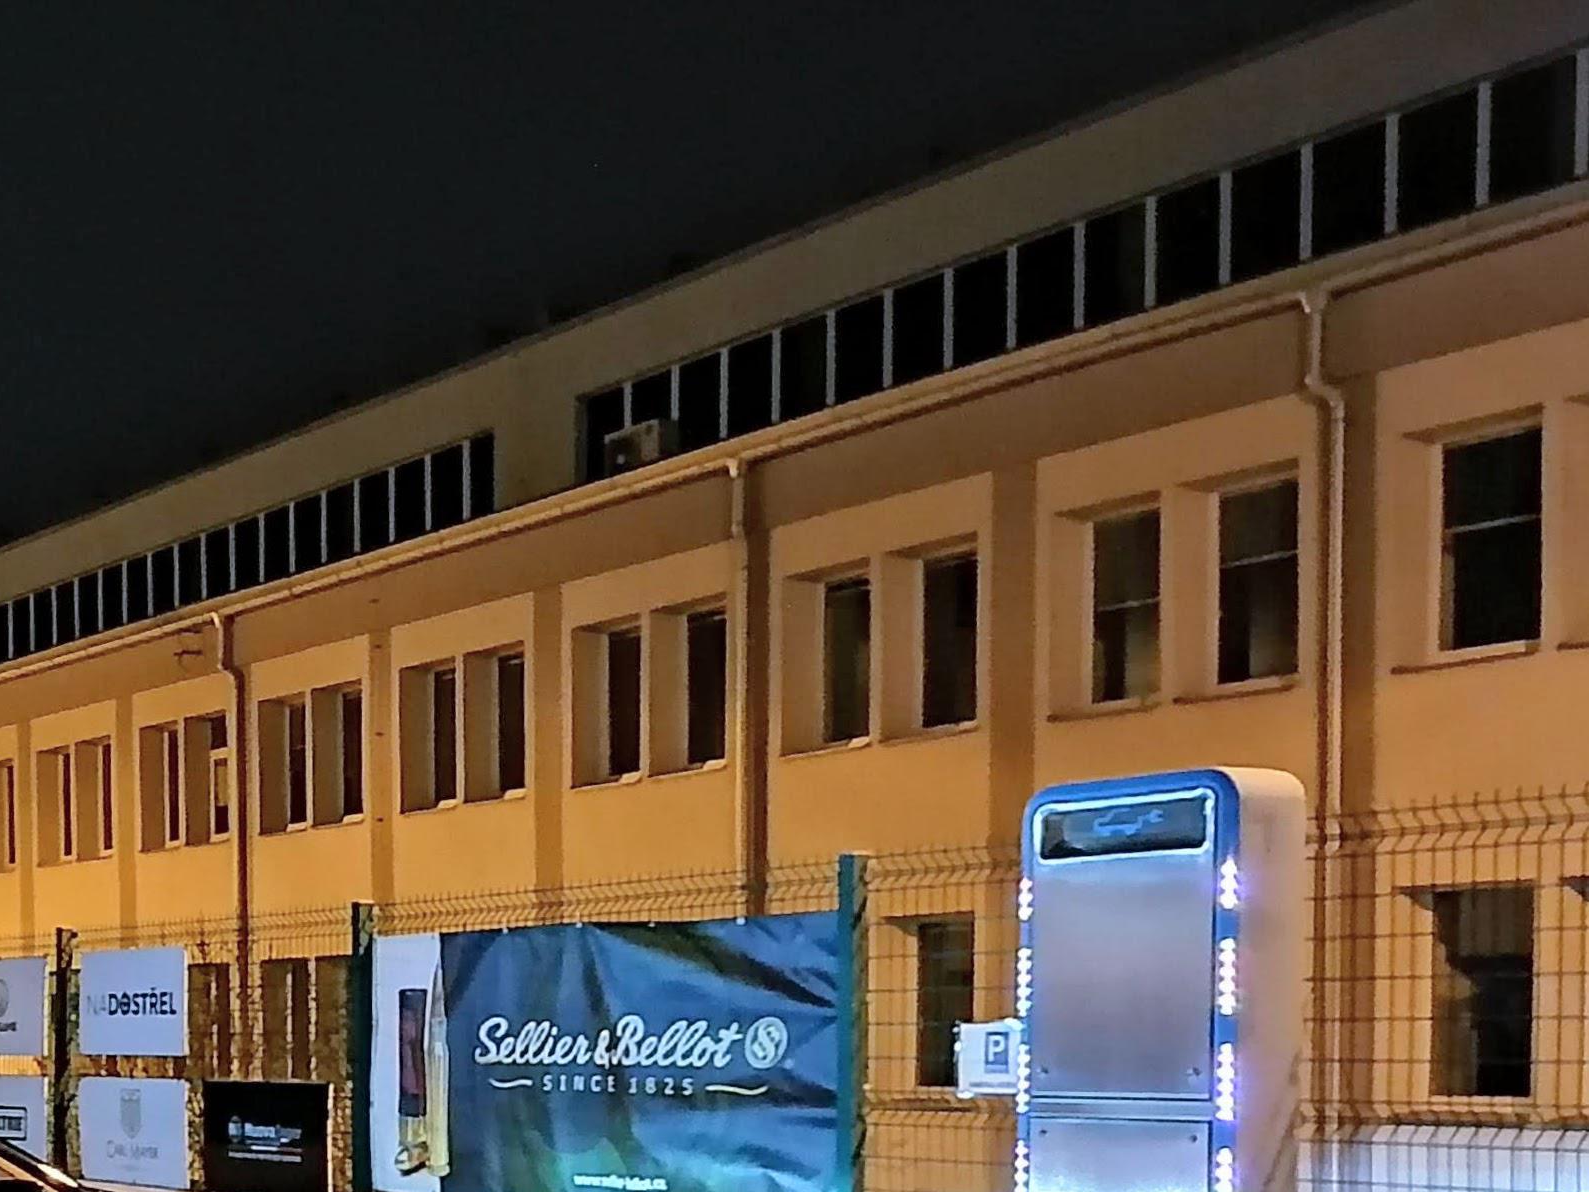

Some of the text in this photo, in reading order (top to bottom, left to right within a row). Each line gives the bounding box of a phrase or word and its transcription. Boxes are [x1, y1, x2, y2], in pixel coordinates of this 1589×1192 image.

[988, 1035, 1006, 1063] P
[542, 1074, 695, 1096] SINCE 1825
